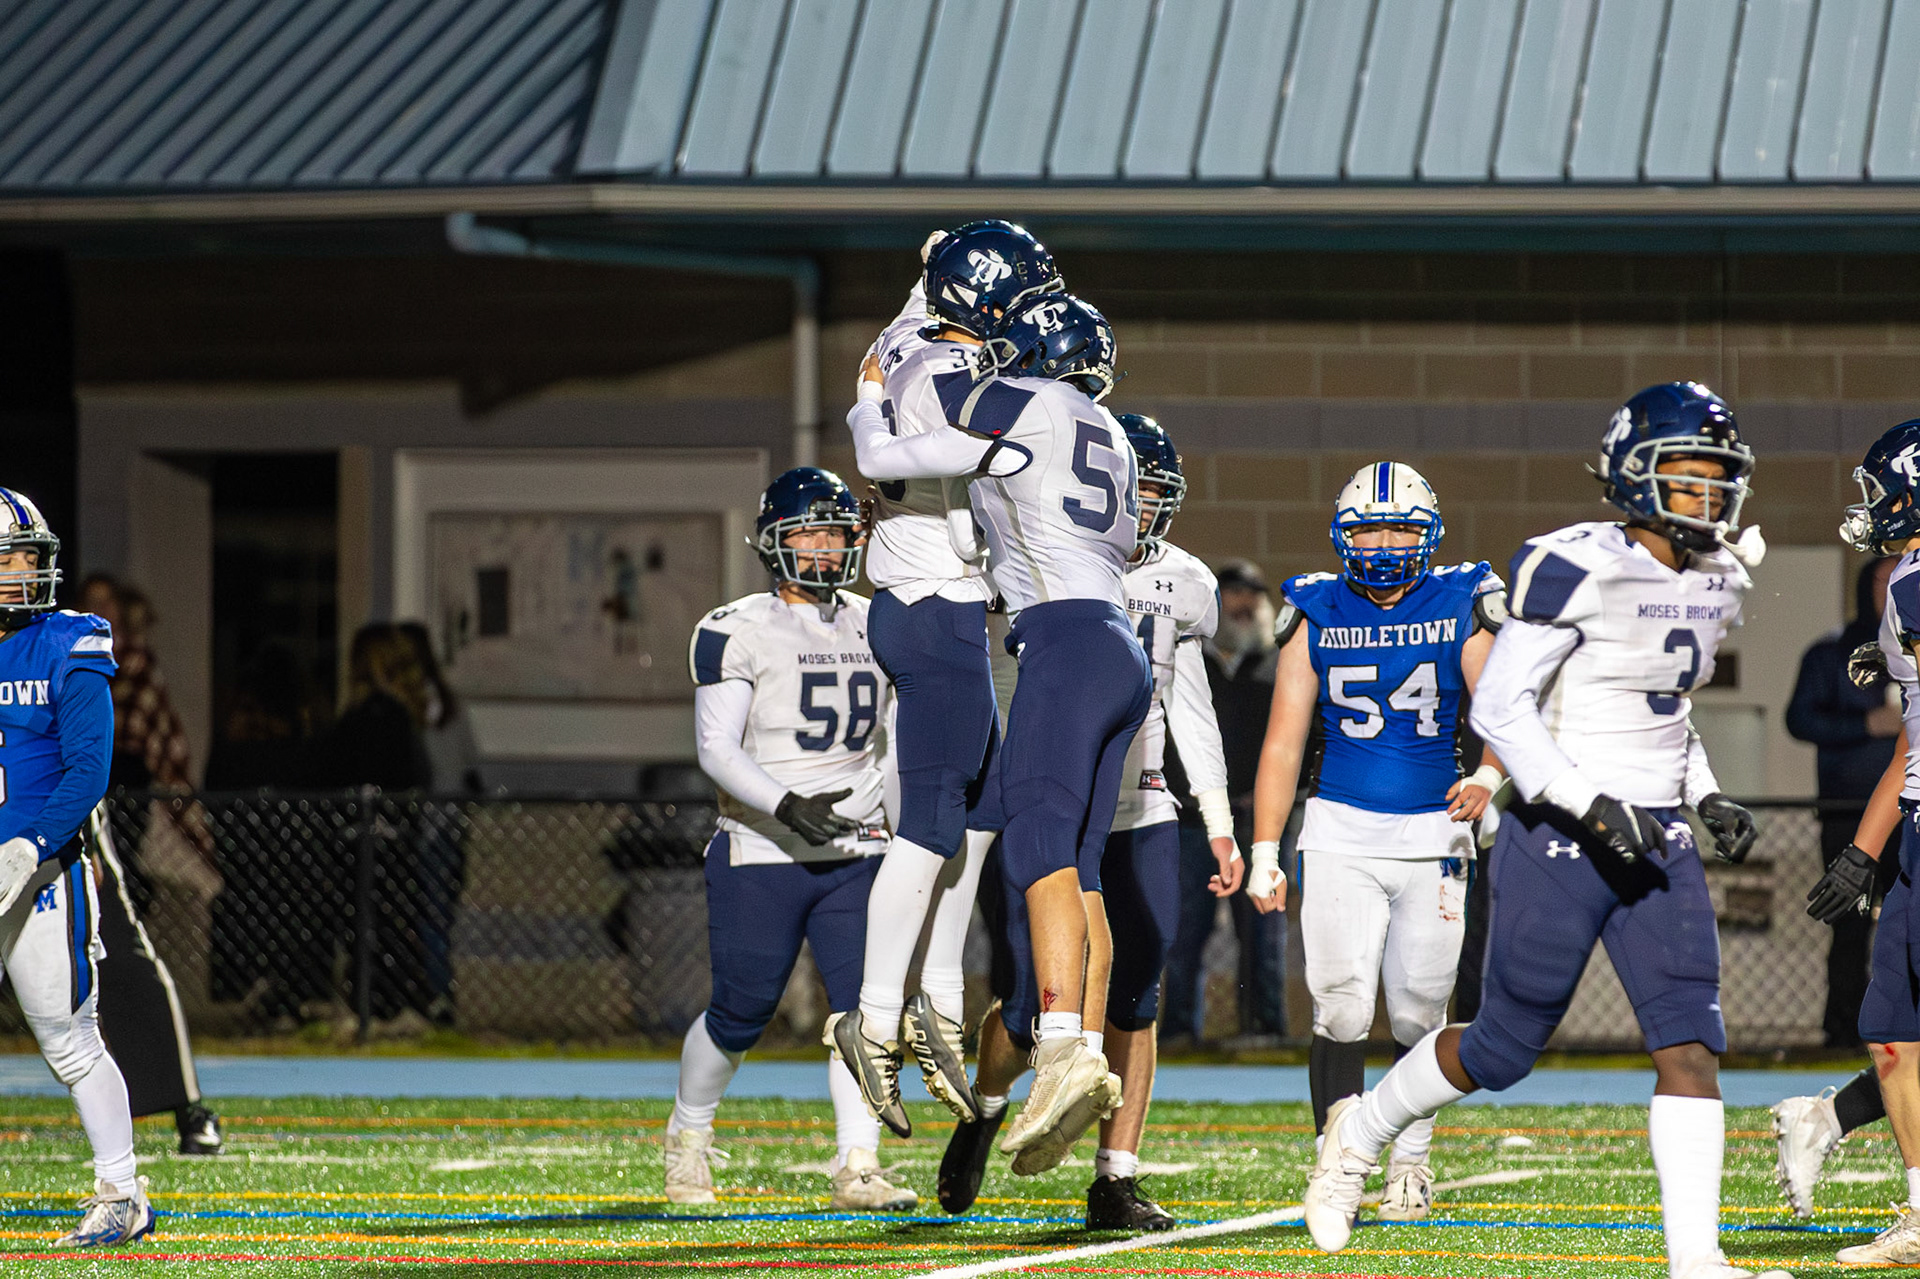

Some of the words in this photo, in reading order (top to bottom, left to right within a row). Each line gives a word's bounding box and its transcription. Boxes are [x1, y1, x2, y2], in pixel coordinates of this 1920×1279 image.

[1128, 599, 1172, 616] BROWN
[1638, 603, 1680, 619] MOSES
[1686, 604, 1725, 620] BROWN
[798, 653, 837, 665] MOSES
[1646, 627, 1702, 715] 3
[795, 671, 878, 751] 58
[1327, 661, 1440, 740] 54
